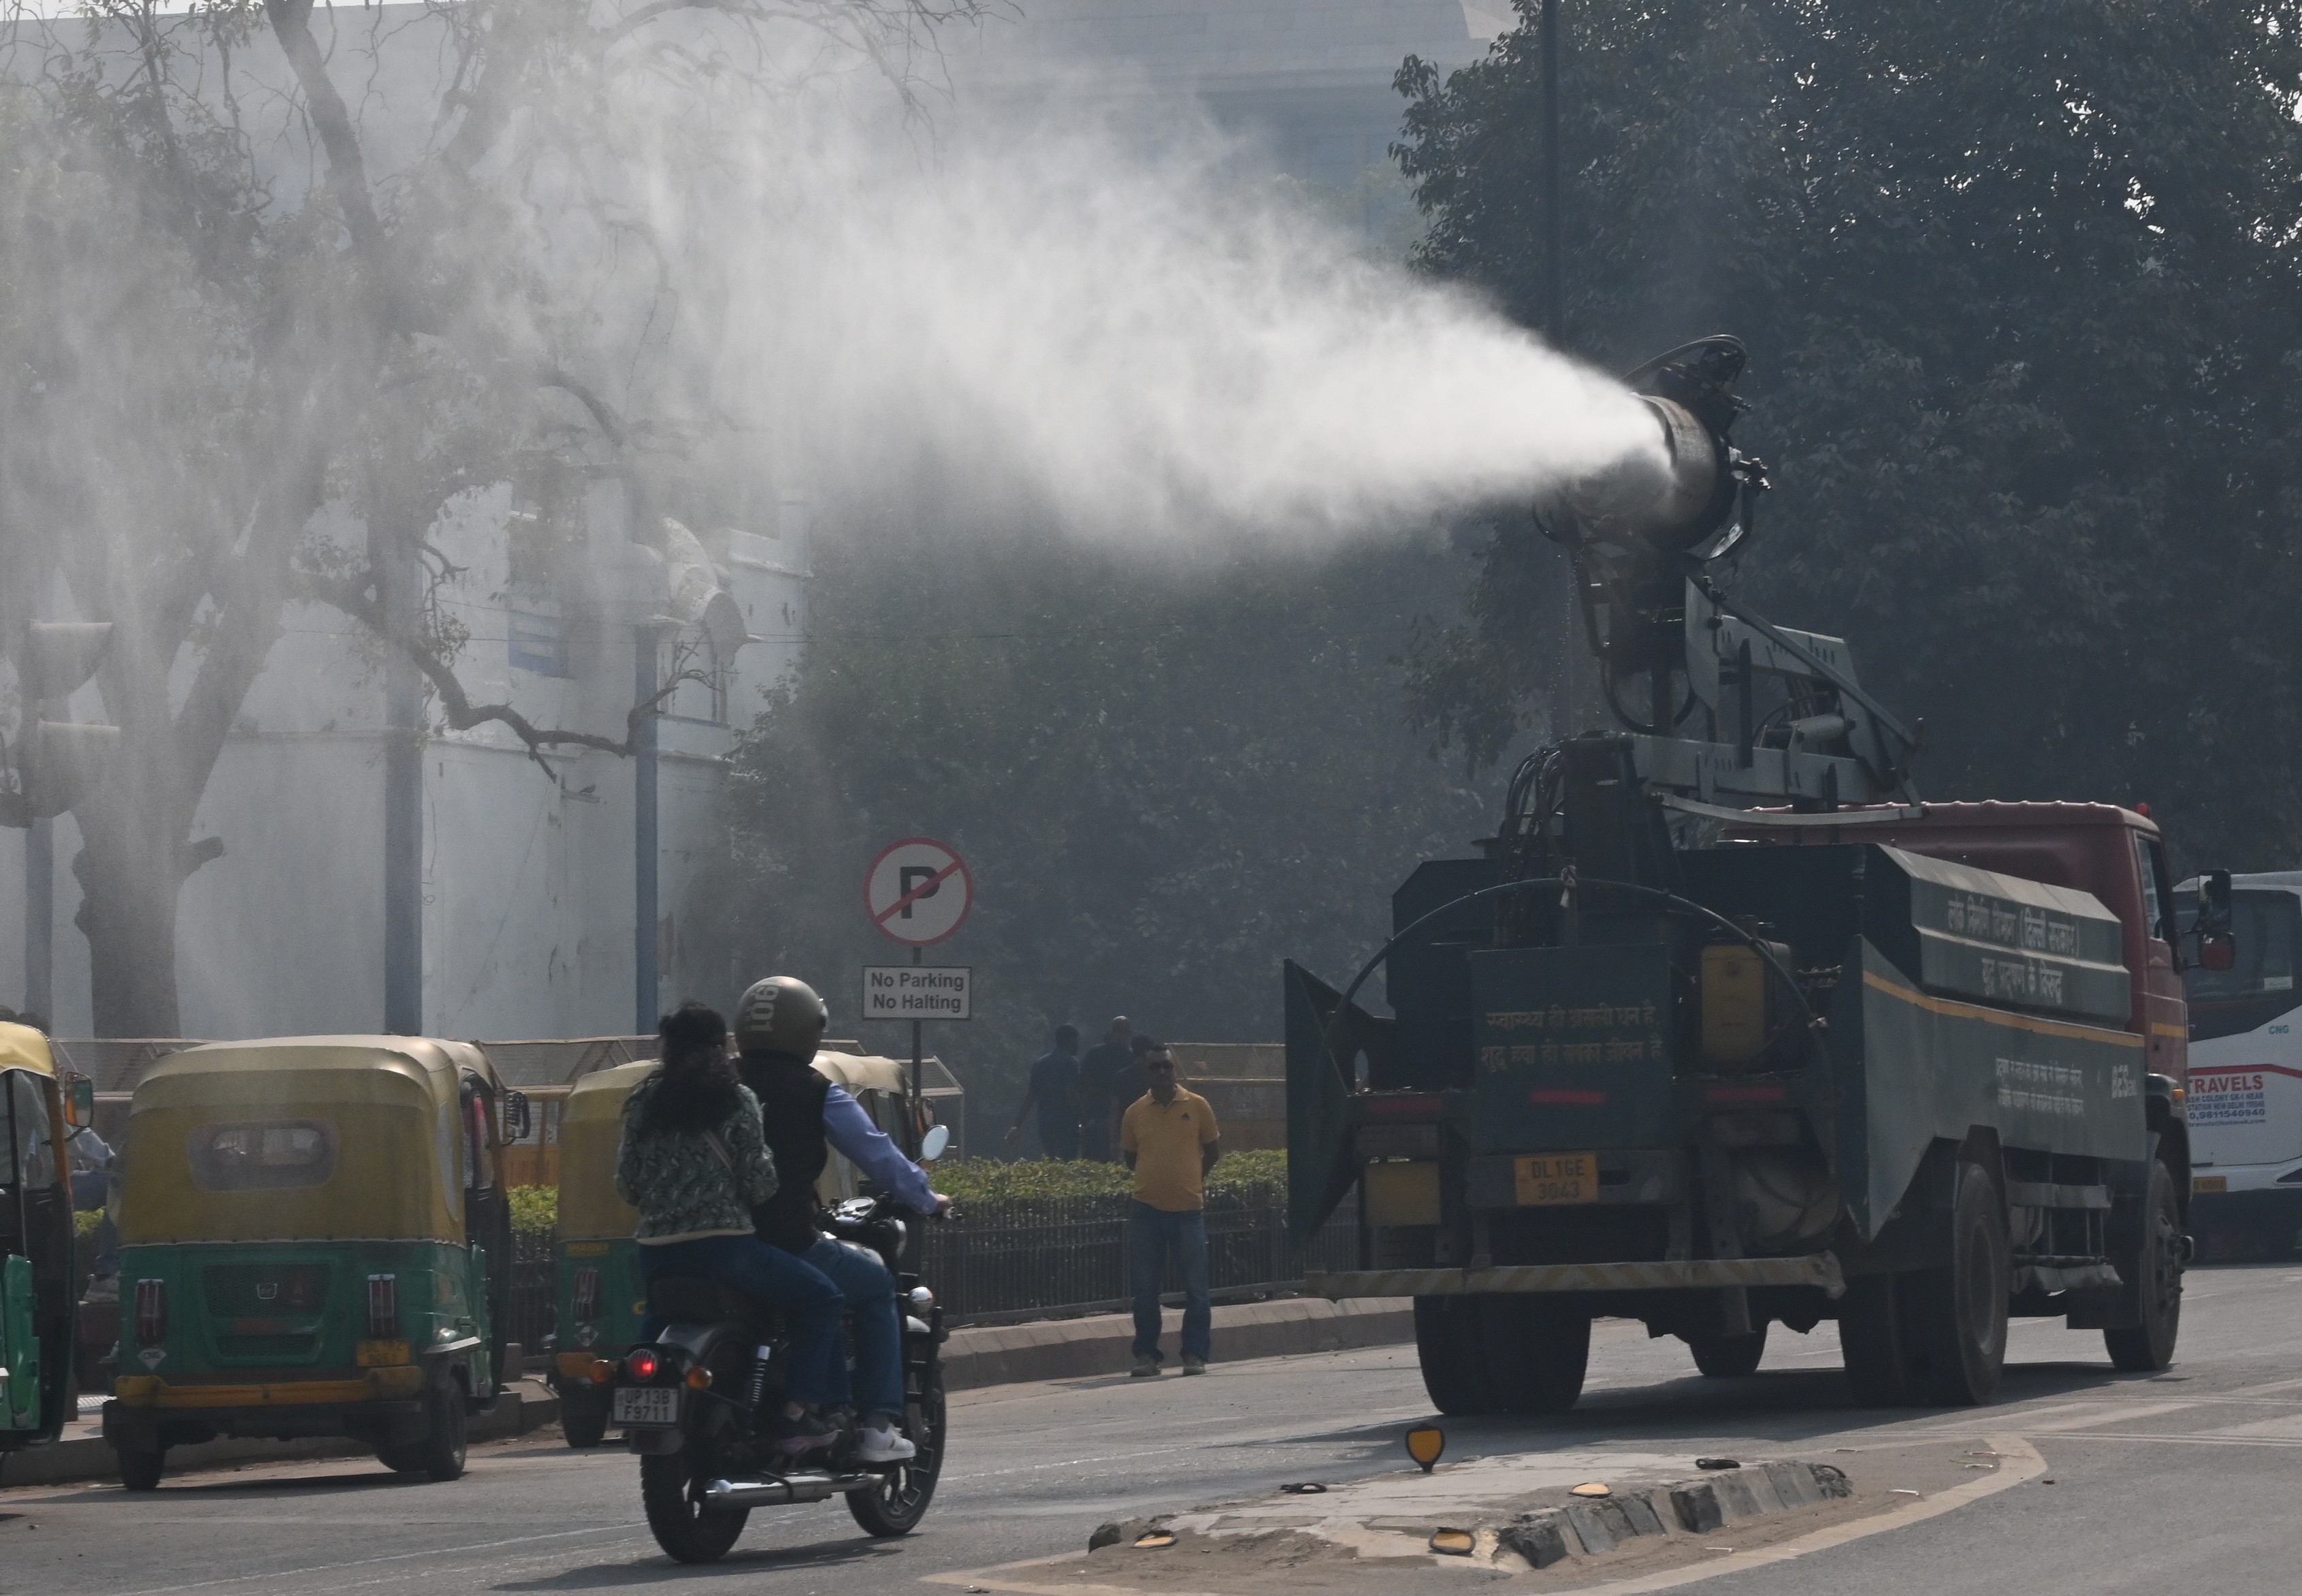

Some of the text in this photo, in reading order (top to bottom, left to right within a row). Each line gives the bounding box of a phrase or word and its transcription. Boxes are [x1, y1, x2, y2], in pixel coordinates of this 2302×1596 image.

[900, 866, 940, 919] P
[871, 973, 964, 992] No Parking
[873, 994, 961, 1013] No Halting
[2269, 1024, 2289, 1034] CNG
